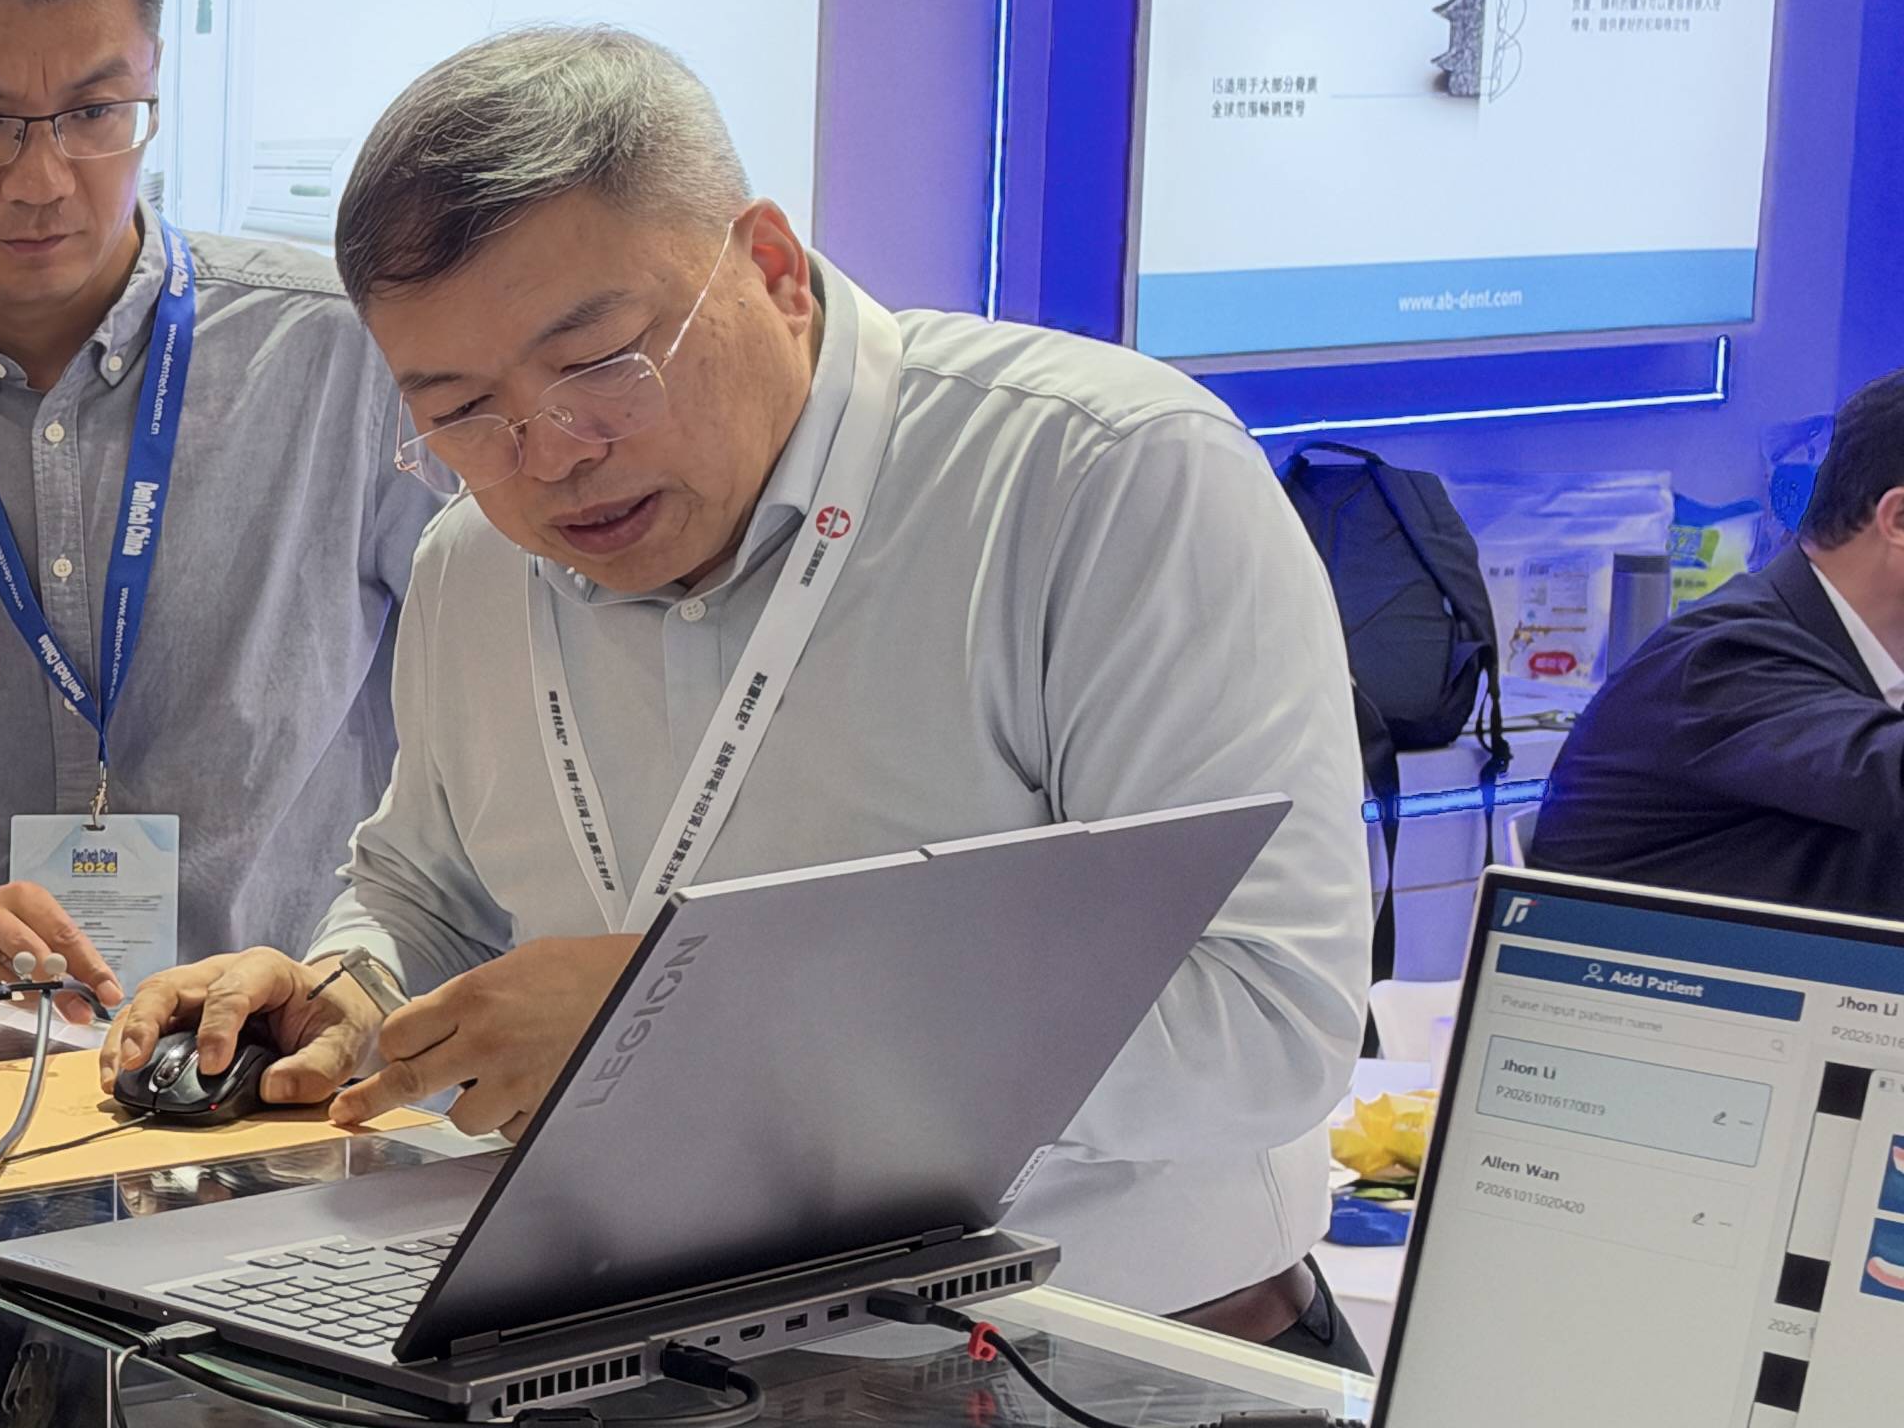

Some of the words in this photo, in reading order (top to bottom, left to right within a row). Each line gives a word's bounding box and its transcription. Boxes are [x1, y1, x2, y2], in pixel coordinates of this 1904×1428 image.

[73, 862, 117, 873] 2026
[1610, 970, 1643, 989] Add
[1646, 975, 1705, 999] Patient
[1837, 996, 1879, 1014] Jhon
[575, 933, 709, 1110] LEGION
[1500, 1058, 1538, 1077] Jhon
[1543, 1066, 1556, 1080] Li
[1480, 1154, 1520, 1174] Allen
[1525, 1162, 1560, 1182] Wan
